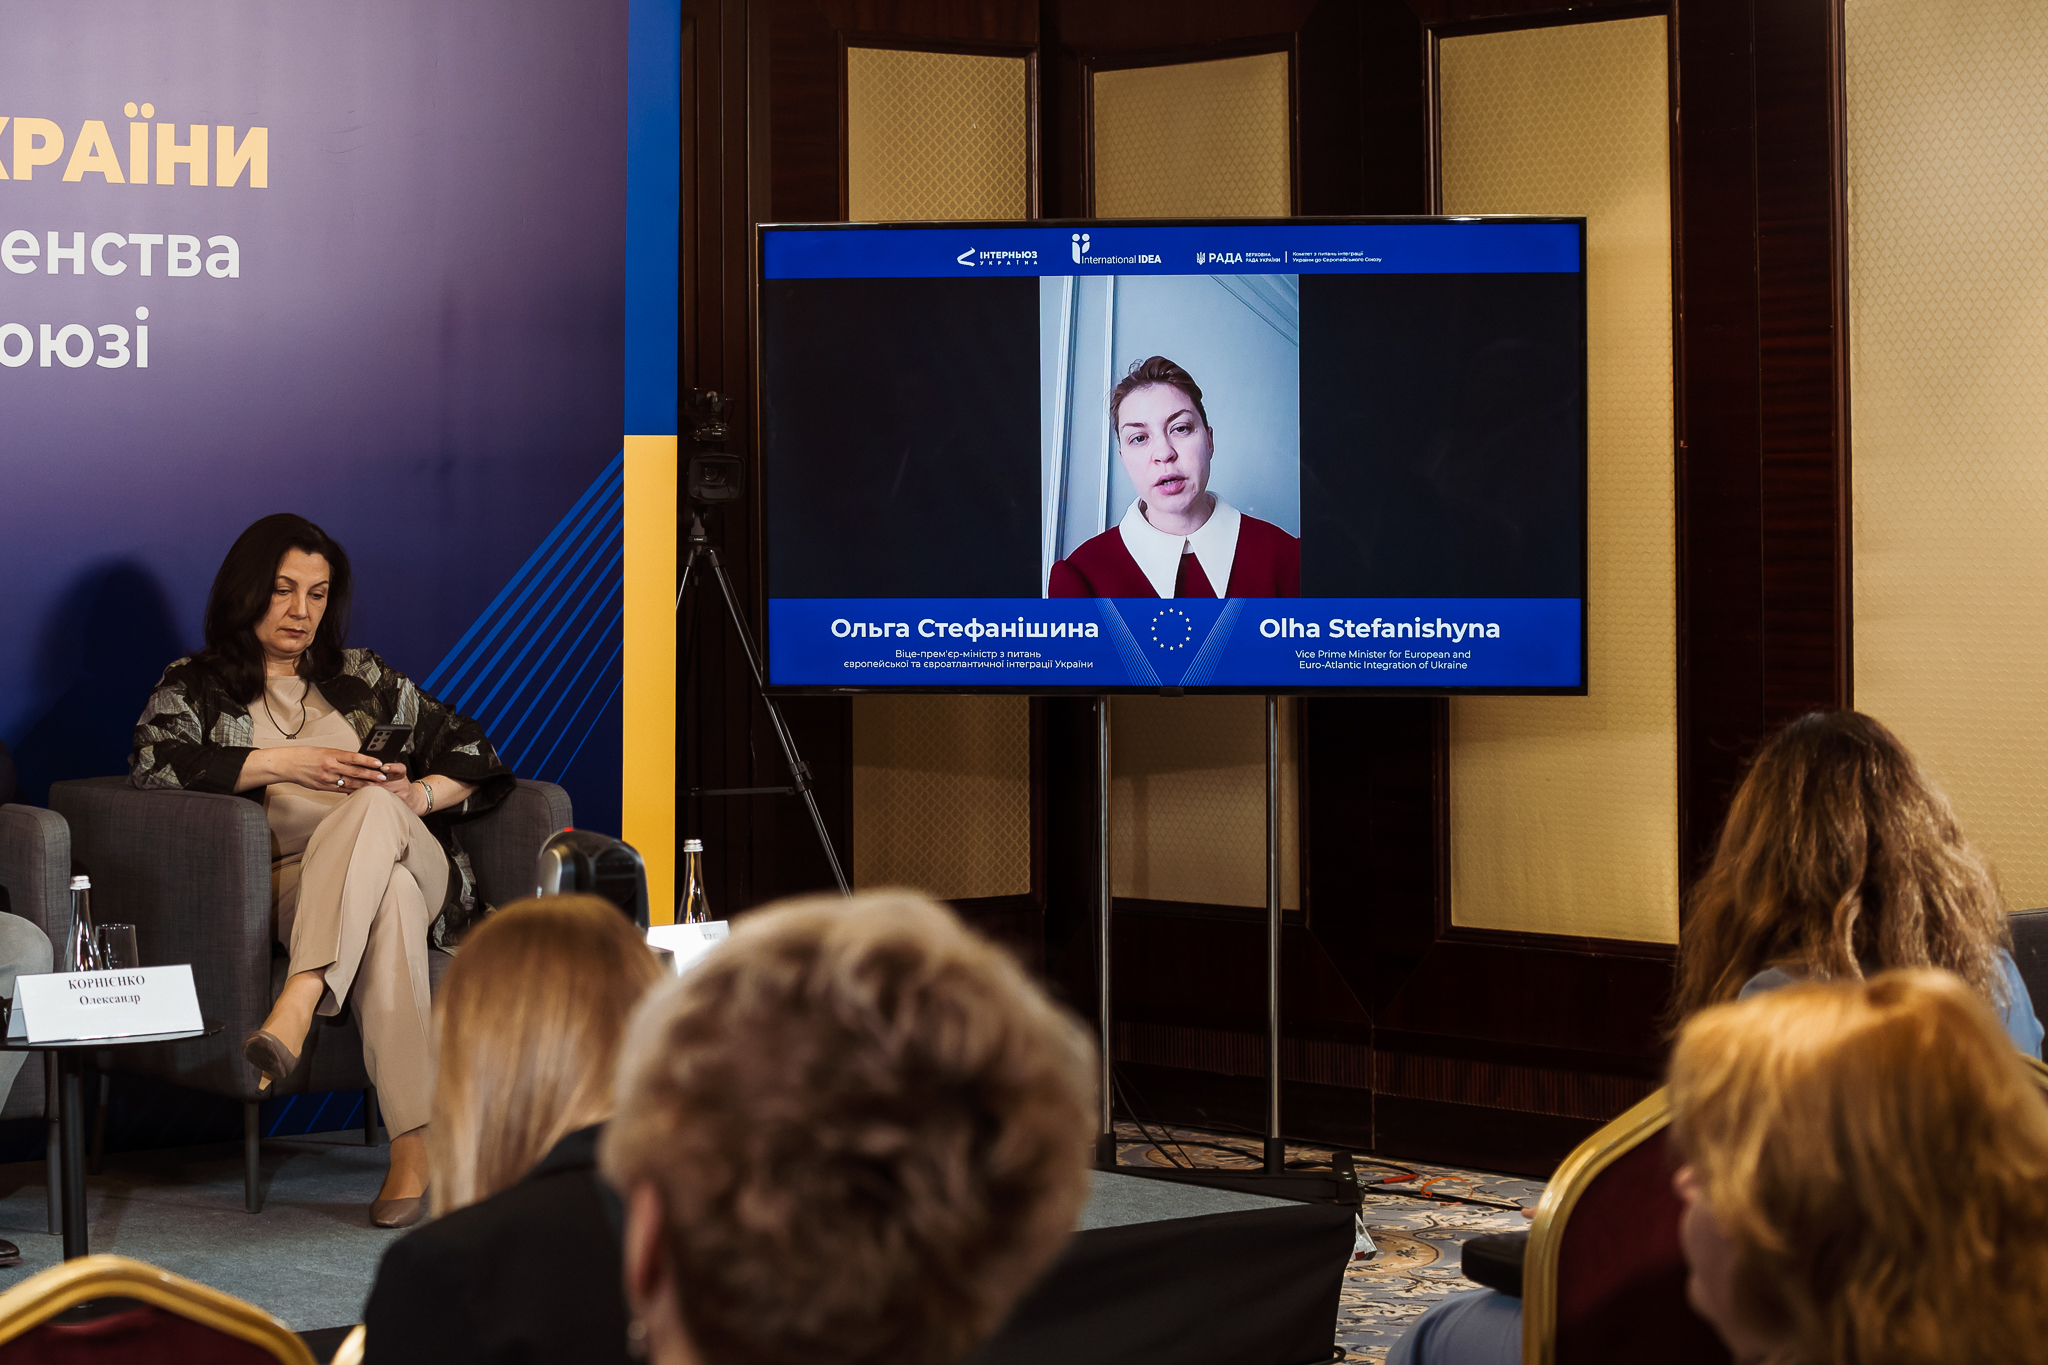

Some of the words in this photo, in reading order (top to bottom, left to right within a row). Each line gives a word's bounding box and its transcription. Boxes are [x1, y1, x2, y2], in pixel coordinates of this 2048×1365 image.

[0, 102, 268, 188] РАЇНИ
[1, 230, 240, 278] енства
[979, 251, 1038, 259] ІНТЕРНЬЮЗ
[1081, 254, 1137, 264] International
[1138, 254, 1162, 264] IDEA
[1208, 252, 1243, 265] РАДА
[0, 306, 149, 369] оюзі
[830, 618, 910, 638] Ольга
[917, 616, 1099, 643] Стефанішина
[1259, 618, 1321, 638] Olha
[1328, 616, 1500, 643] Stefanishyna
[895, 649, 998, 660] Віце-прем'єр-міністр
[1007, 651, 1042, 659] питань
[1295, 650, 1316, 659] Vice
[1317, 650, 1347, 659] Prime
[1348, 650, 1387, 659] Minister
[1388, 650, 1402, 659] for
[1404, 650, 1451, 660] European
[1452, 650, 1471, 659] and
[843, 659, 909, 669] європейської
[923, 659, 1005, 669] євроатлантичної
[1006, 659, 1053, 669] інтеграції
[1054, 659, 1094, 669] України
[1299, 660, 1362, 669] Euro-Atlantic
[1363, 660, 1417, 671] Integration
[1418, 660, 1429, 669] of
[1430, 660, 1468, 669] Ukraine
[68, 974, 146, 990] КОРНІЄНКО
[79, 994, 141, 1006] Олександр
